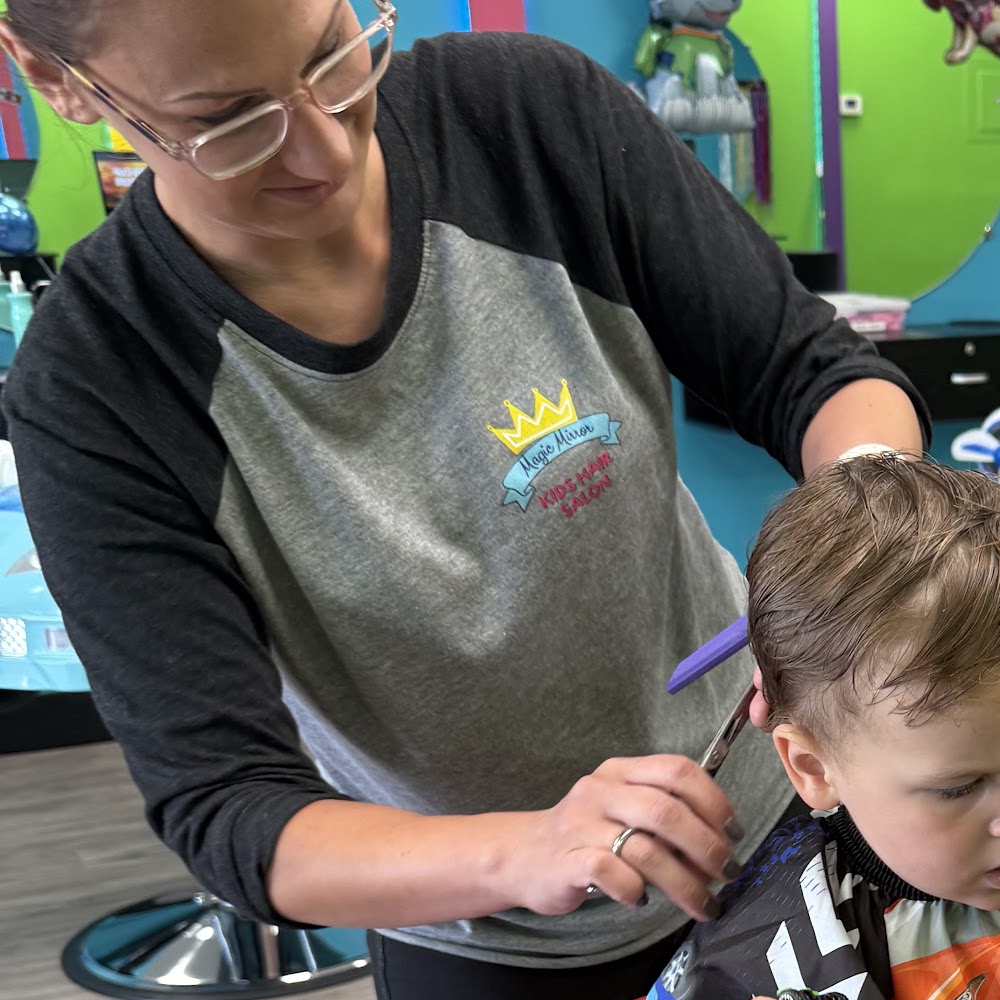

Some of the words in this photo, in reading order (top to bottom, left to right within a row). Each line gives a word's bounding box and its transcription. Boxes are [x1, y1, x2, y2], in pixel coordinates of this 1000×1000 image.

[519, 443, 556, 479] Magic
[554, 423, 595, 452] Mirror
[538, 477, 577, 509] KIDS
[575, 450, 613, 486] HAIR
[560, 473, 613, 518] SALON
